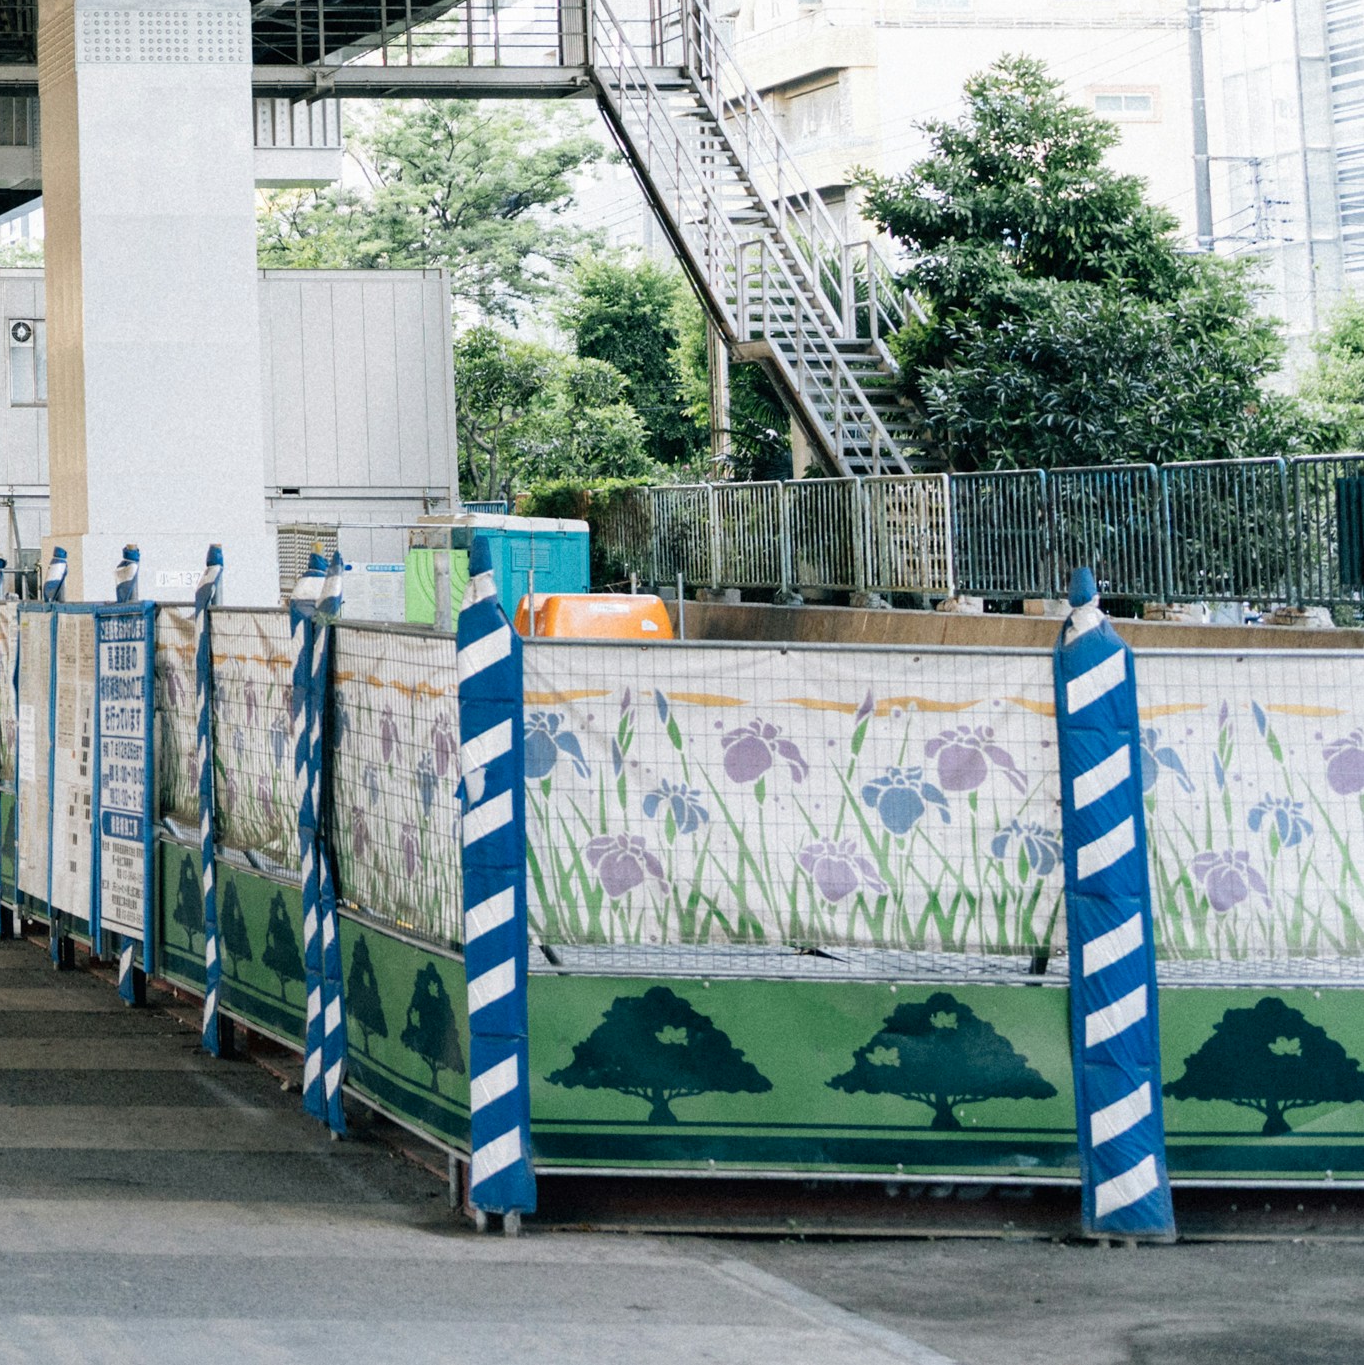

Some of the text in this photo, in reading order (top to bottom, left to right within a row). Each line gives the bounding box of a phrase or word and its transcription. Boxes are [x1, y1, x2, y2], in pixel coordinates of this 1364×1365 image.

[107, 645, 138, 671] 高速道路の
[105, 705, 141, 732] を行っています
